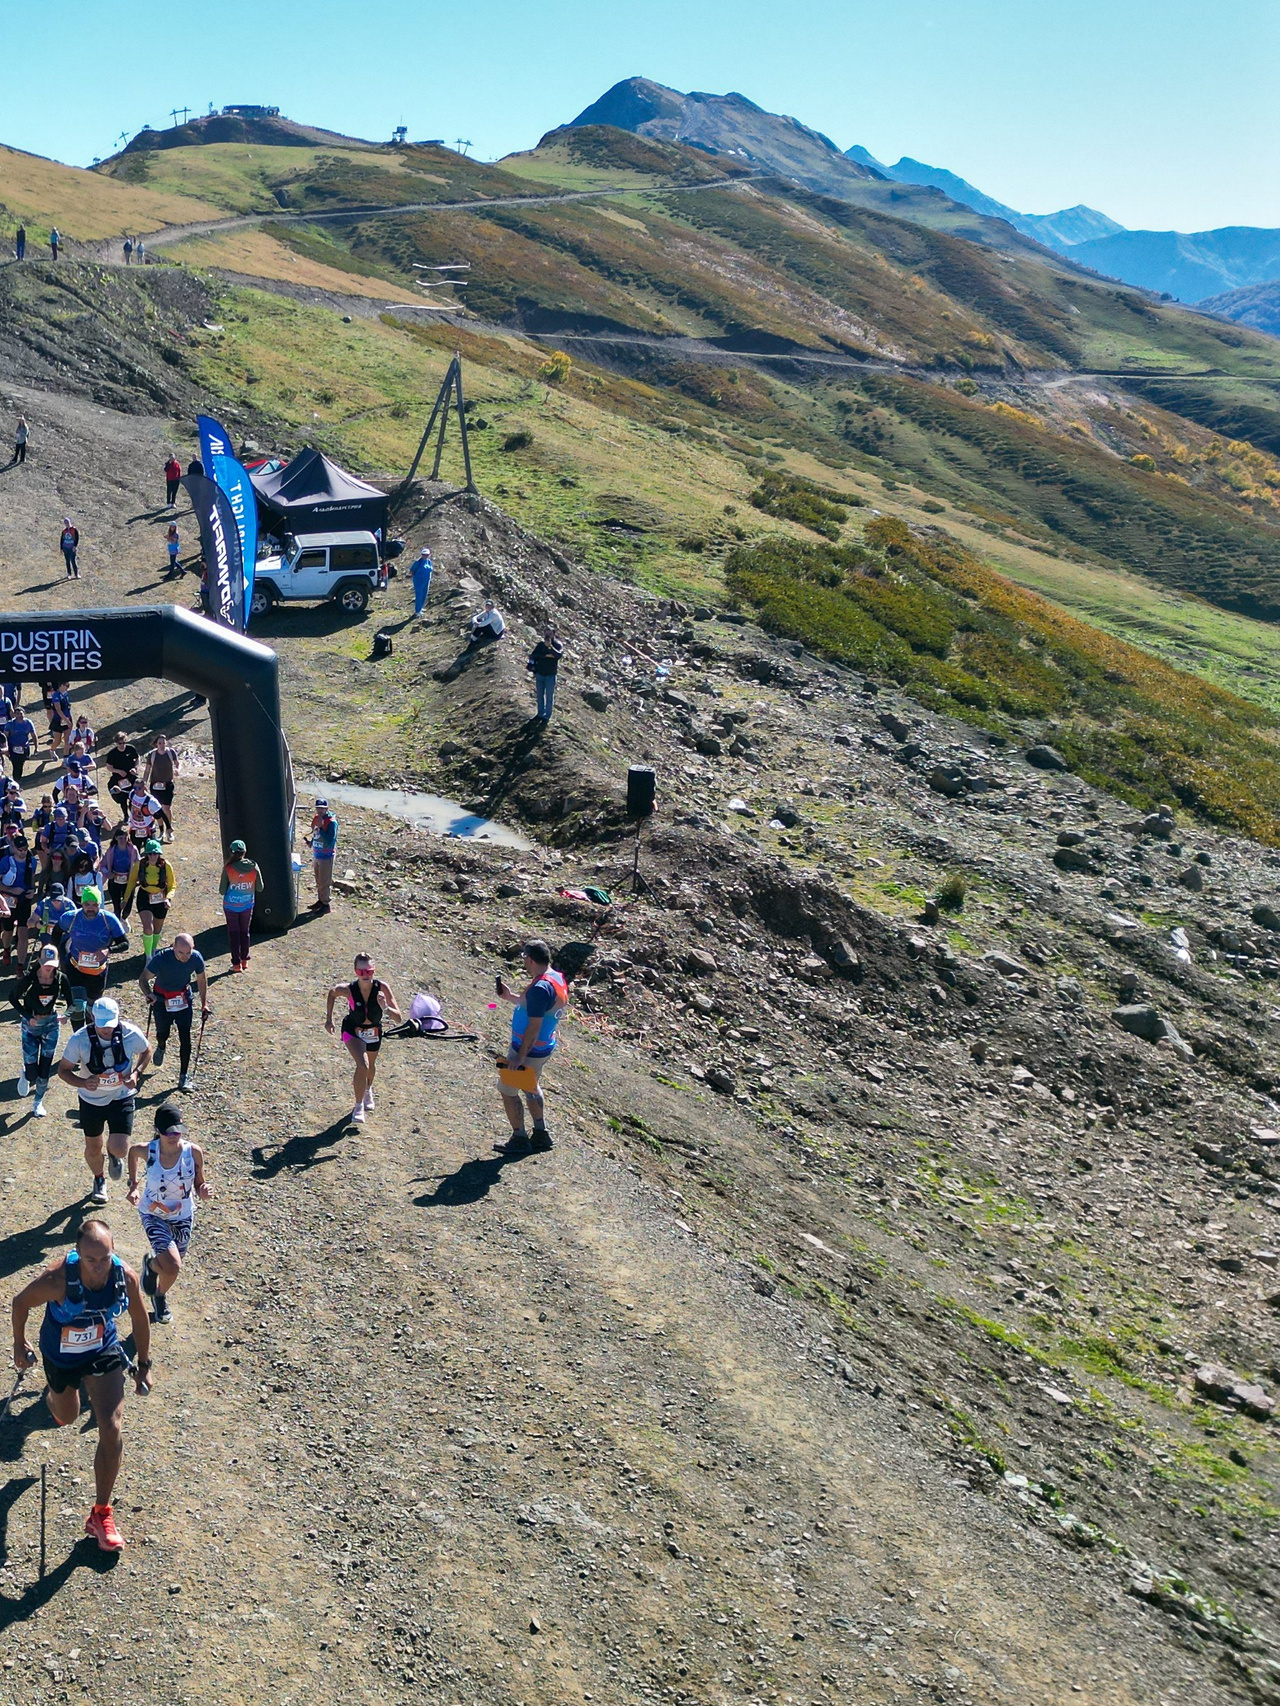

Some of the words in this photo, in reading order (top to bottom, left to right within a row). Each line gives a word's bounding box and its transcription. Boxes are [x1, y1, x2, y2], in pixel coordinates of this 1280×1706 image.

[12, 651, 103, 673] SERIES
[230, 882, 253, 891] CREW
[101, 1077, 116, 1085] 762
[75, 1332, 93, 1343] 731
